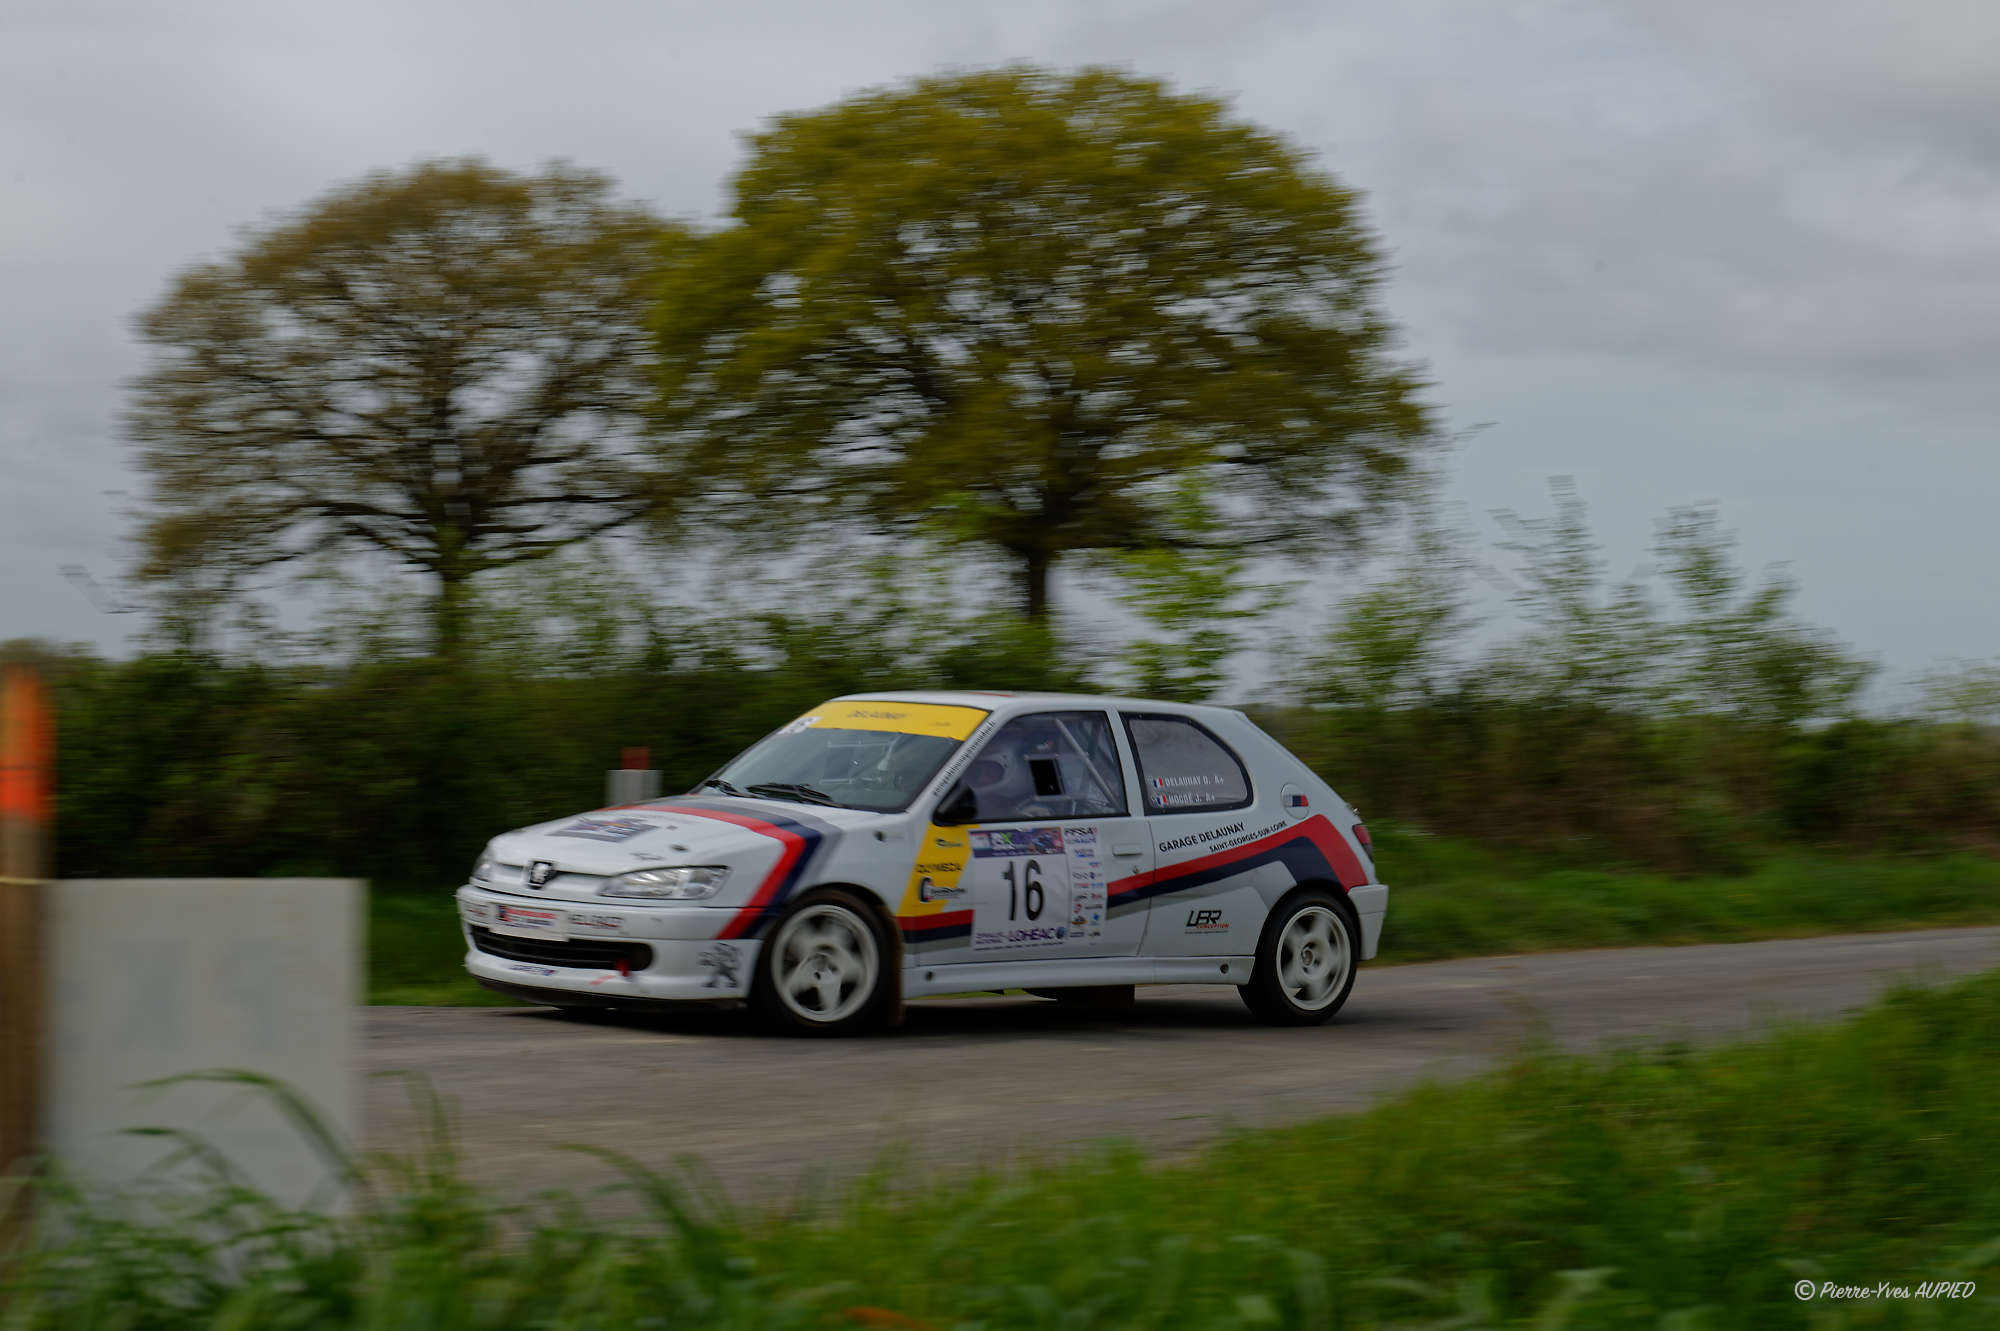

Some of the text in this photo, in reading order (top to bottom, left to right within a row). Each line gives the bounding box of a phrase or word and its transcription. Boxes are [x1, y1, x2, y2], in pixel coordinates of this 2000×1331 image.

[1158, 822, 1245, 853] GARAGE DELAUNAY
[1209, 820, 1287, 853] SAINT-GEORGES-SUR-LOIRE
[1001, 859, 1044, 921] 16
